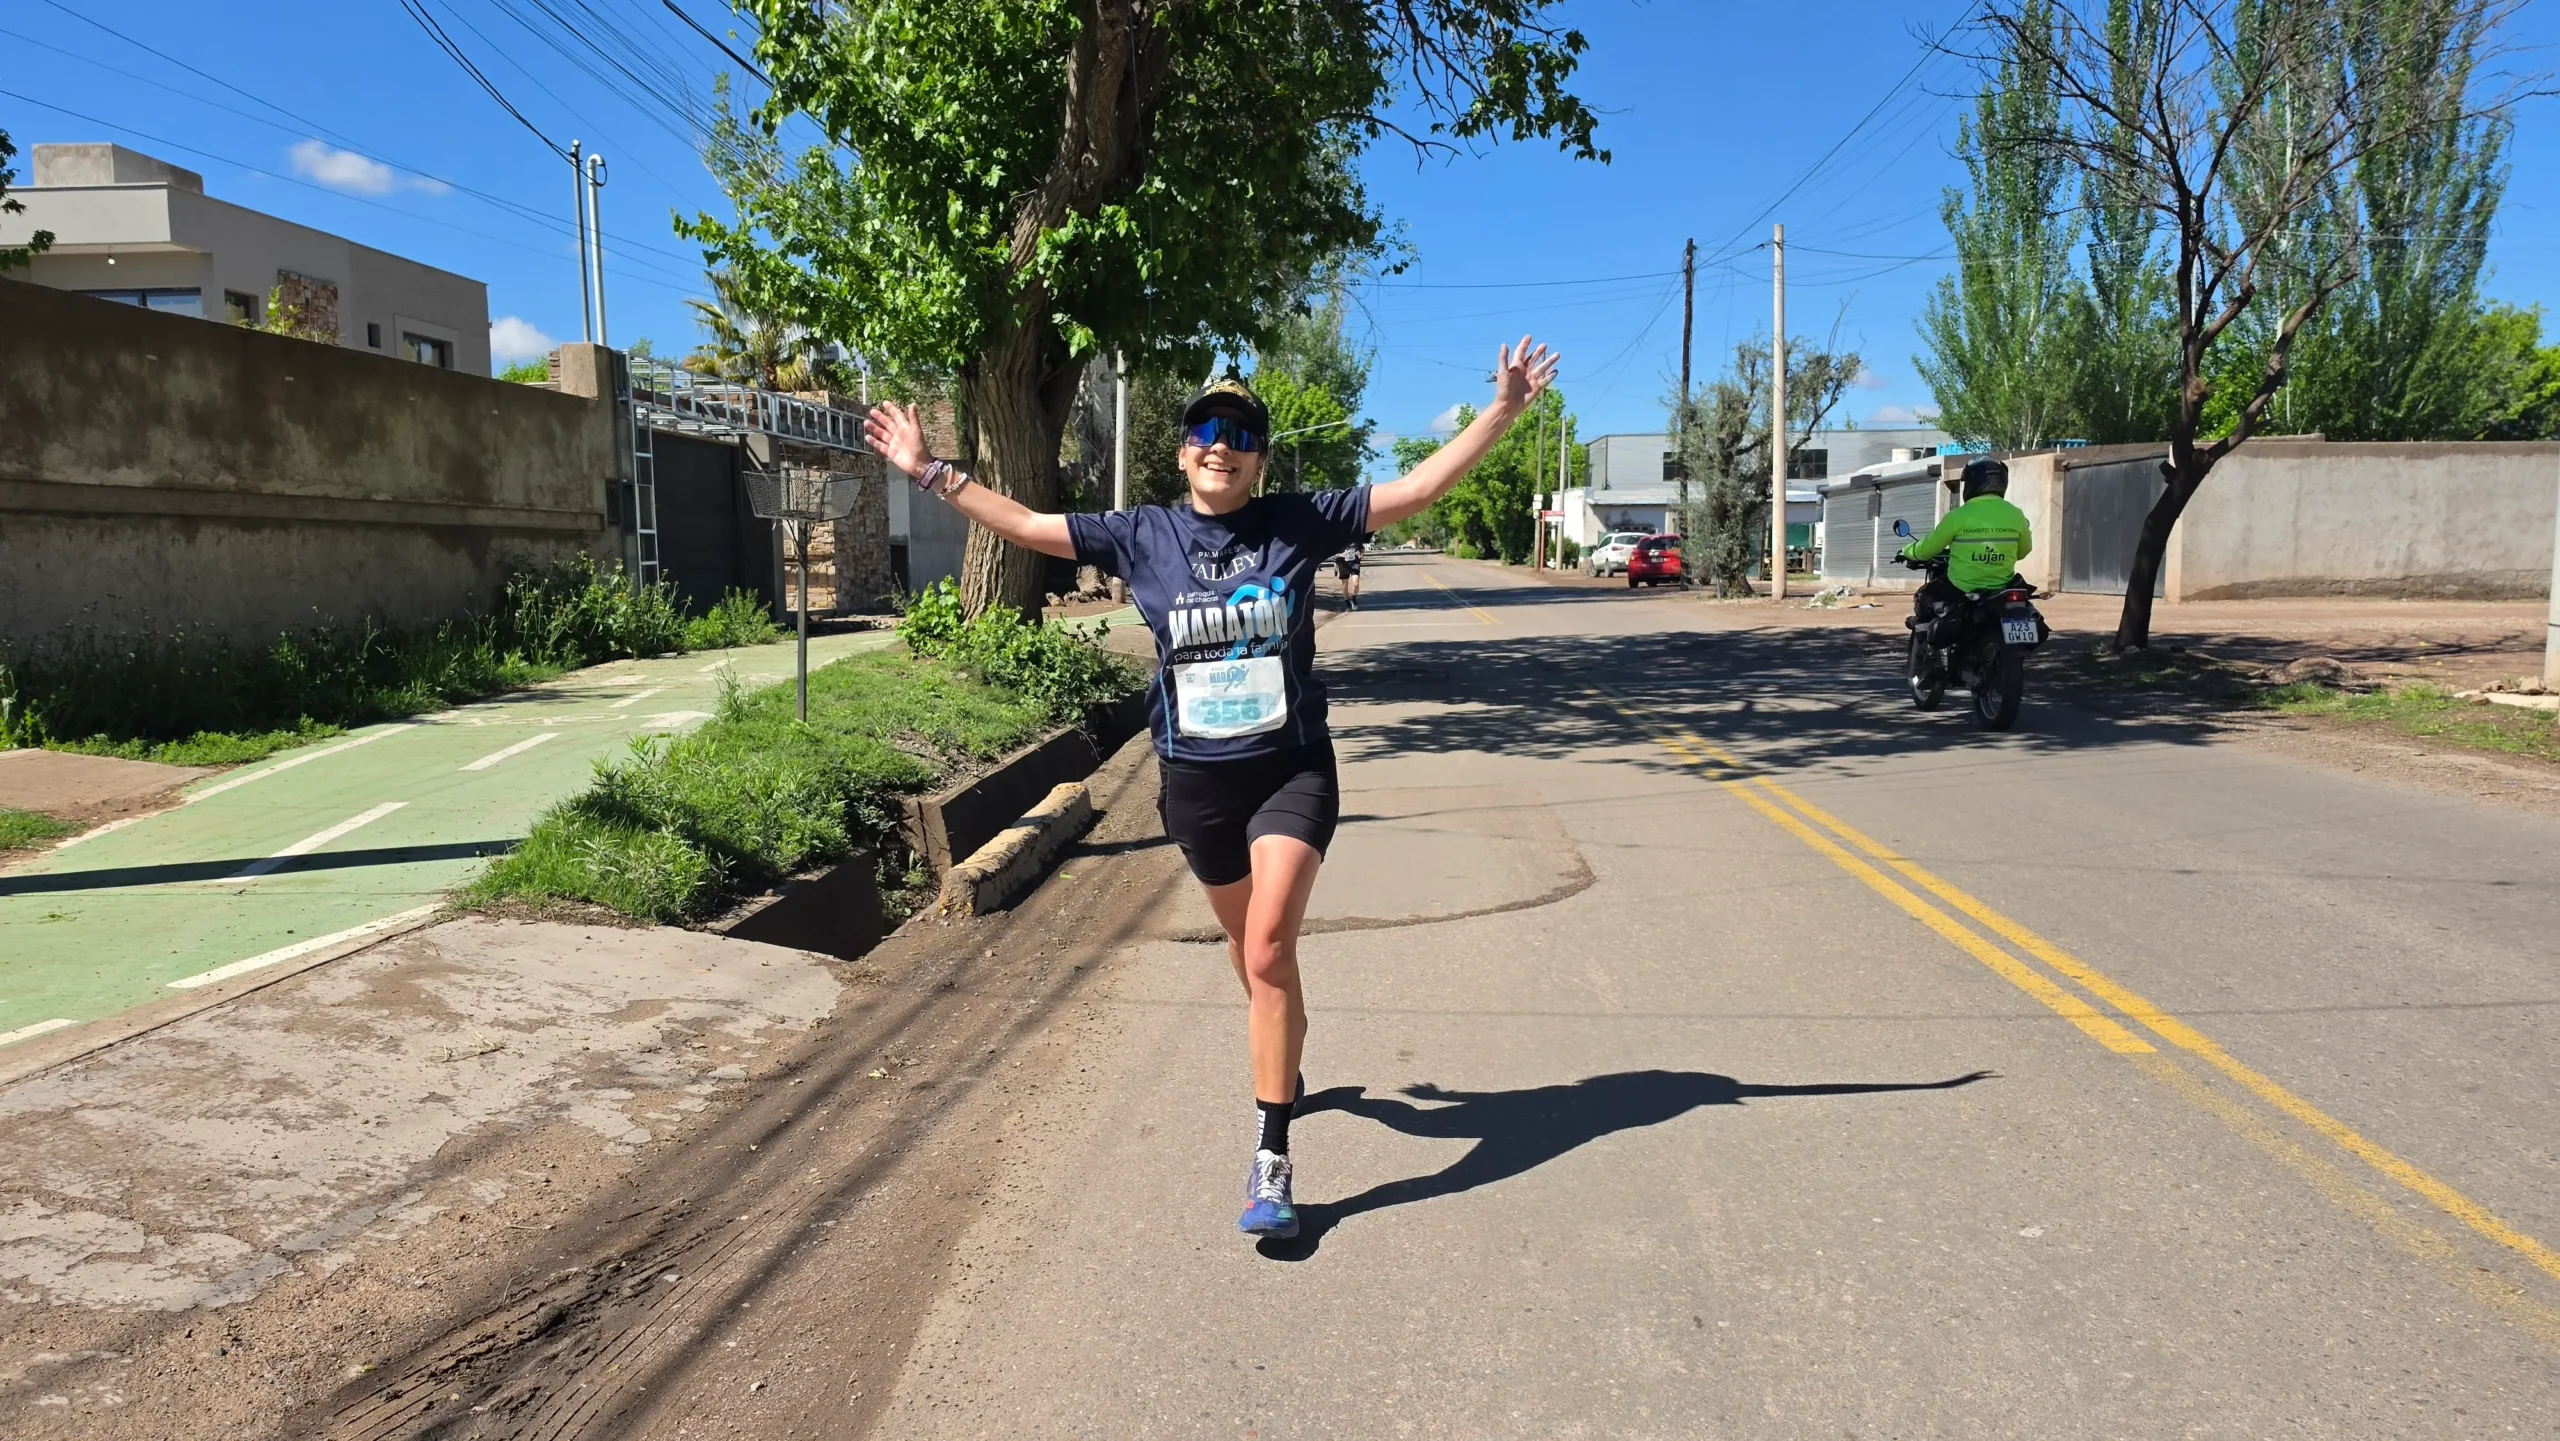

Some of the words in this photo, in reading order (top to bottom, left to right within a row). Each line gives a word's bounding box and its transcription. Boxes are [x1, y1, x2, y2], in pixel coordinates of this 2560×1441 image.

[1198, 545, 1240, 559] PALMARES
[1187, 590, 1215, 599] parroquia
[1195, 595, 1219, 604] chacras
[2011, 623, 2030, 632] A23
[1174, 650, 1202, 663] para
[1204, 644, 1232, 659] toda
[1237, 645, 1248, 656] la
[1250, 639, 1289, 654] familia
[1208, 669, 1246, 684] MARAT
[1201, 697, 1262, 725] 356
